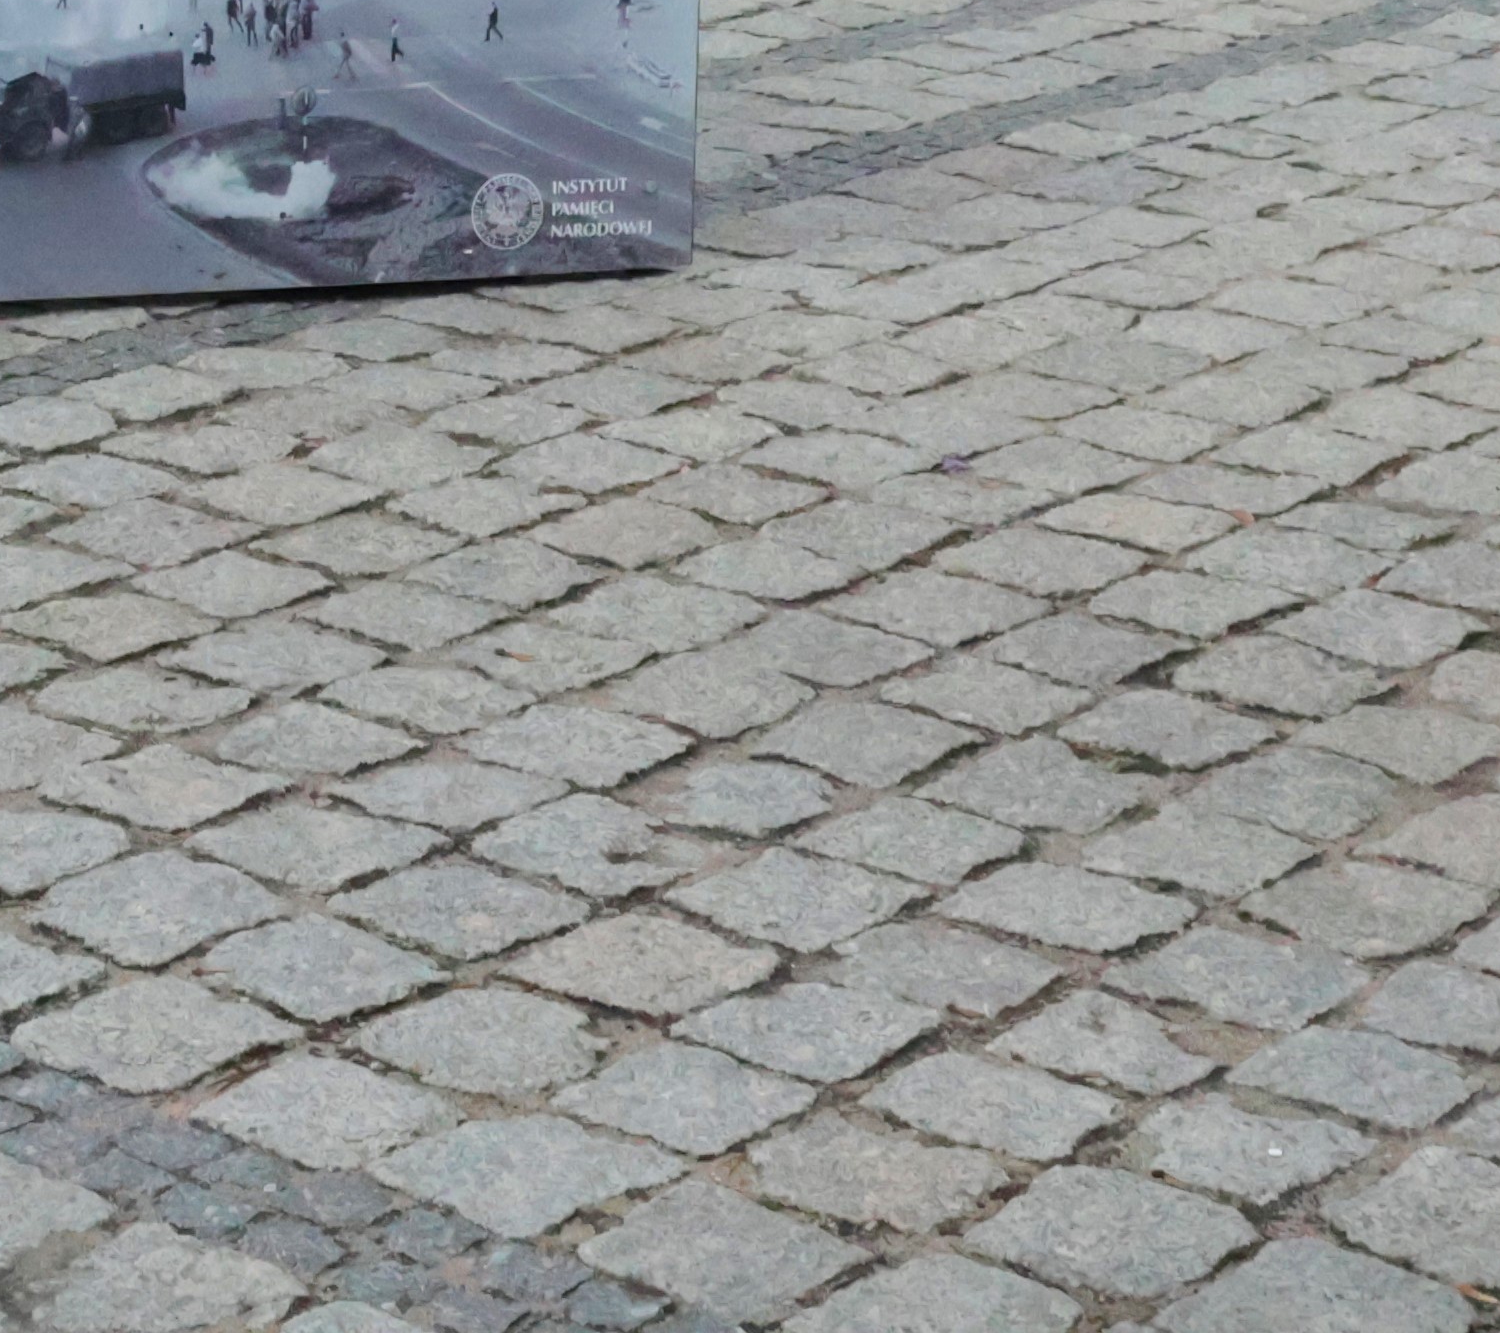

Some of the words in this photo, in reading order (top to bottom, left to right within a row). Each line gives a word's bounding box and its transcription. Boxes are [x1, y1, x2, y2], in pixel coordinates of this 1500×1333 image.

[553, 177, 627, 194] INSTYTUT
[552, 200, 614, 220] PAMIĘCI
[551, 219, 655, 237] NARODOWEJ
